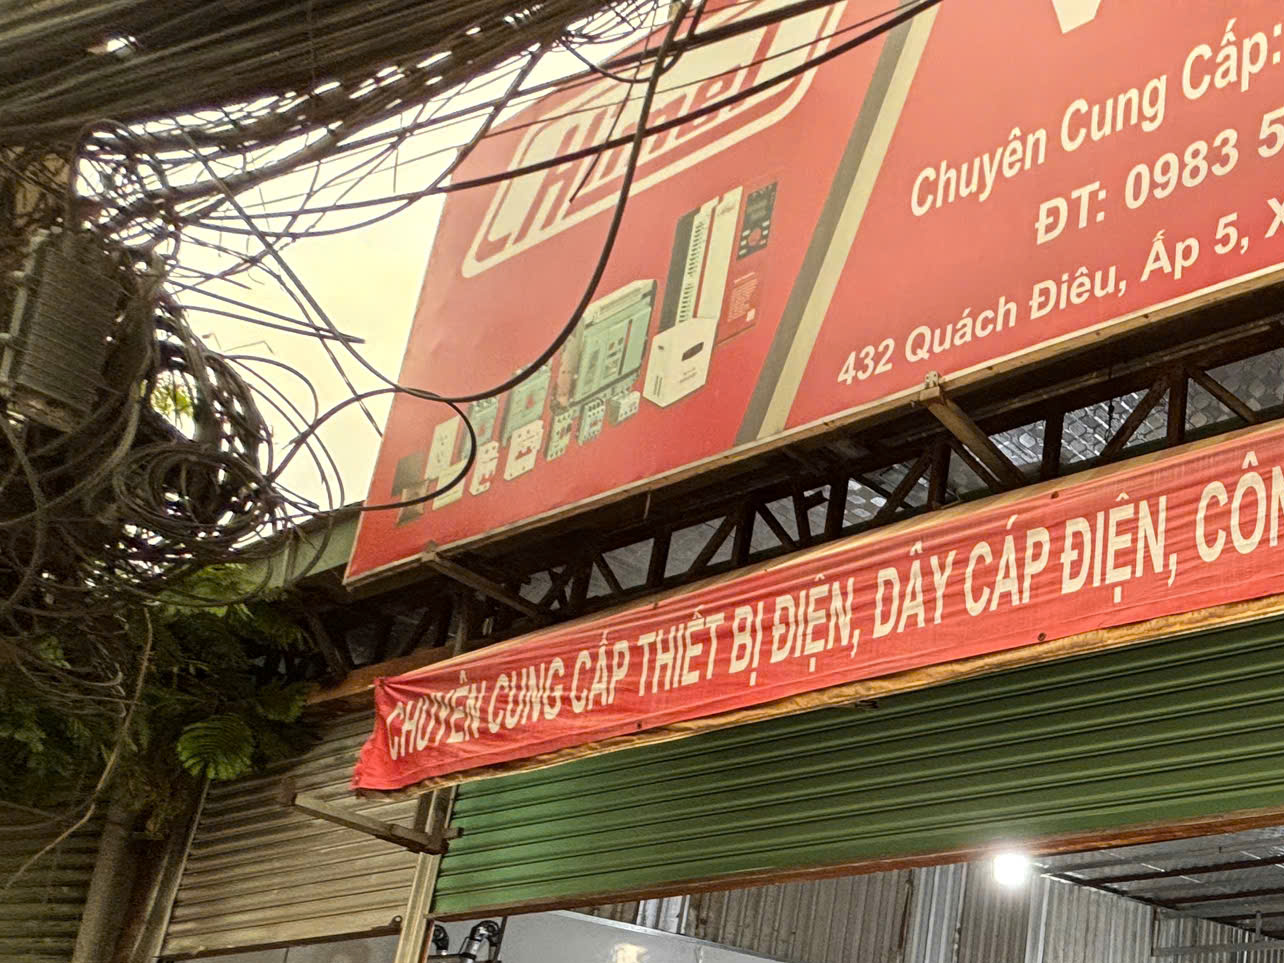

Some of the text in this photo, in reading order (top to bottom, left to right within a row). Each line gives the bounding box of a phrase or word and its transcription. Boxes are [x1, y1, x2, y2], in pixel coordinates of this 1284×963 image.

[912, 127, 1048, 216] Chuyên
[1061, 75, 1167, 152] Cung
[1182, 18, 1283, 101] Cấp:
[1035, 181, 1106, 244] ĐT:
[1125, 129, 1238, 208] 0983
[838, 338, 897, 385] 432
[905, 296, 1016, 362] Quách
[1029, 266, 1127, 320] Điêu,
[1140, 229, 1200, 282] Ấp
[1215, 213, 1250, 256] 5,
[386, 670, 487, 761] CHUYÊN
[488, 657, 565, 734] CUNG
[570, 630, 630, 713] CẤP
[637, 605, 725, 697] THIẾT
[728, 601, 764, 686] BỊ
[770, 574, 860, 672] ĐIỆN,
[873, 538, 956, 639] DÂY
[963, 514, 1051, 617] CÁP
[1060, 492, 1178, 604] ĐIỆN,
